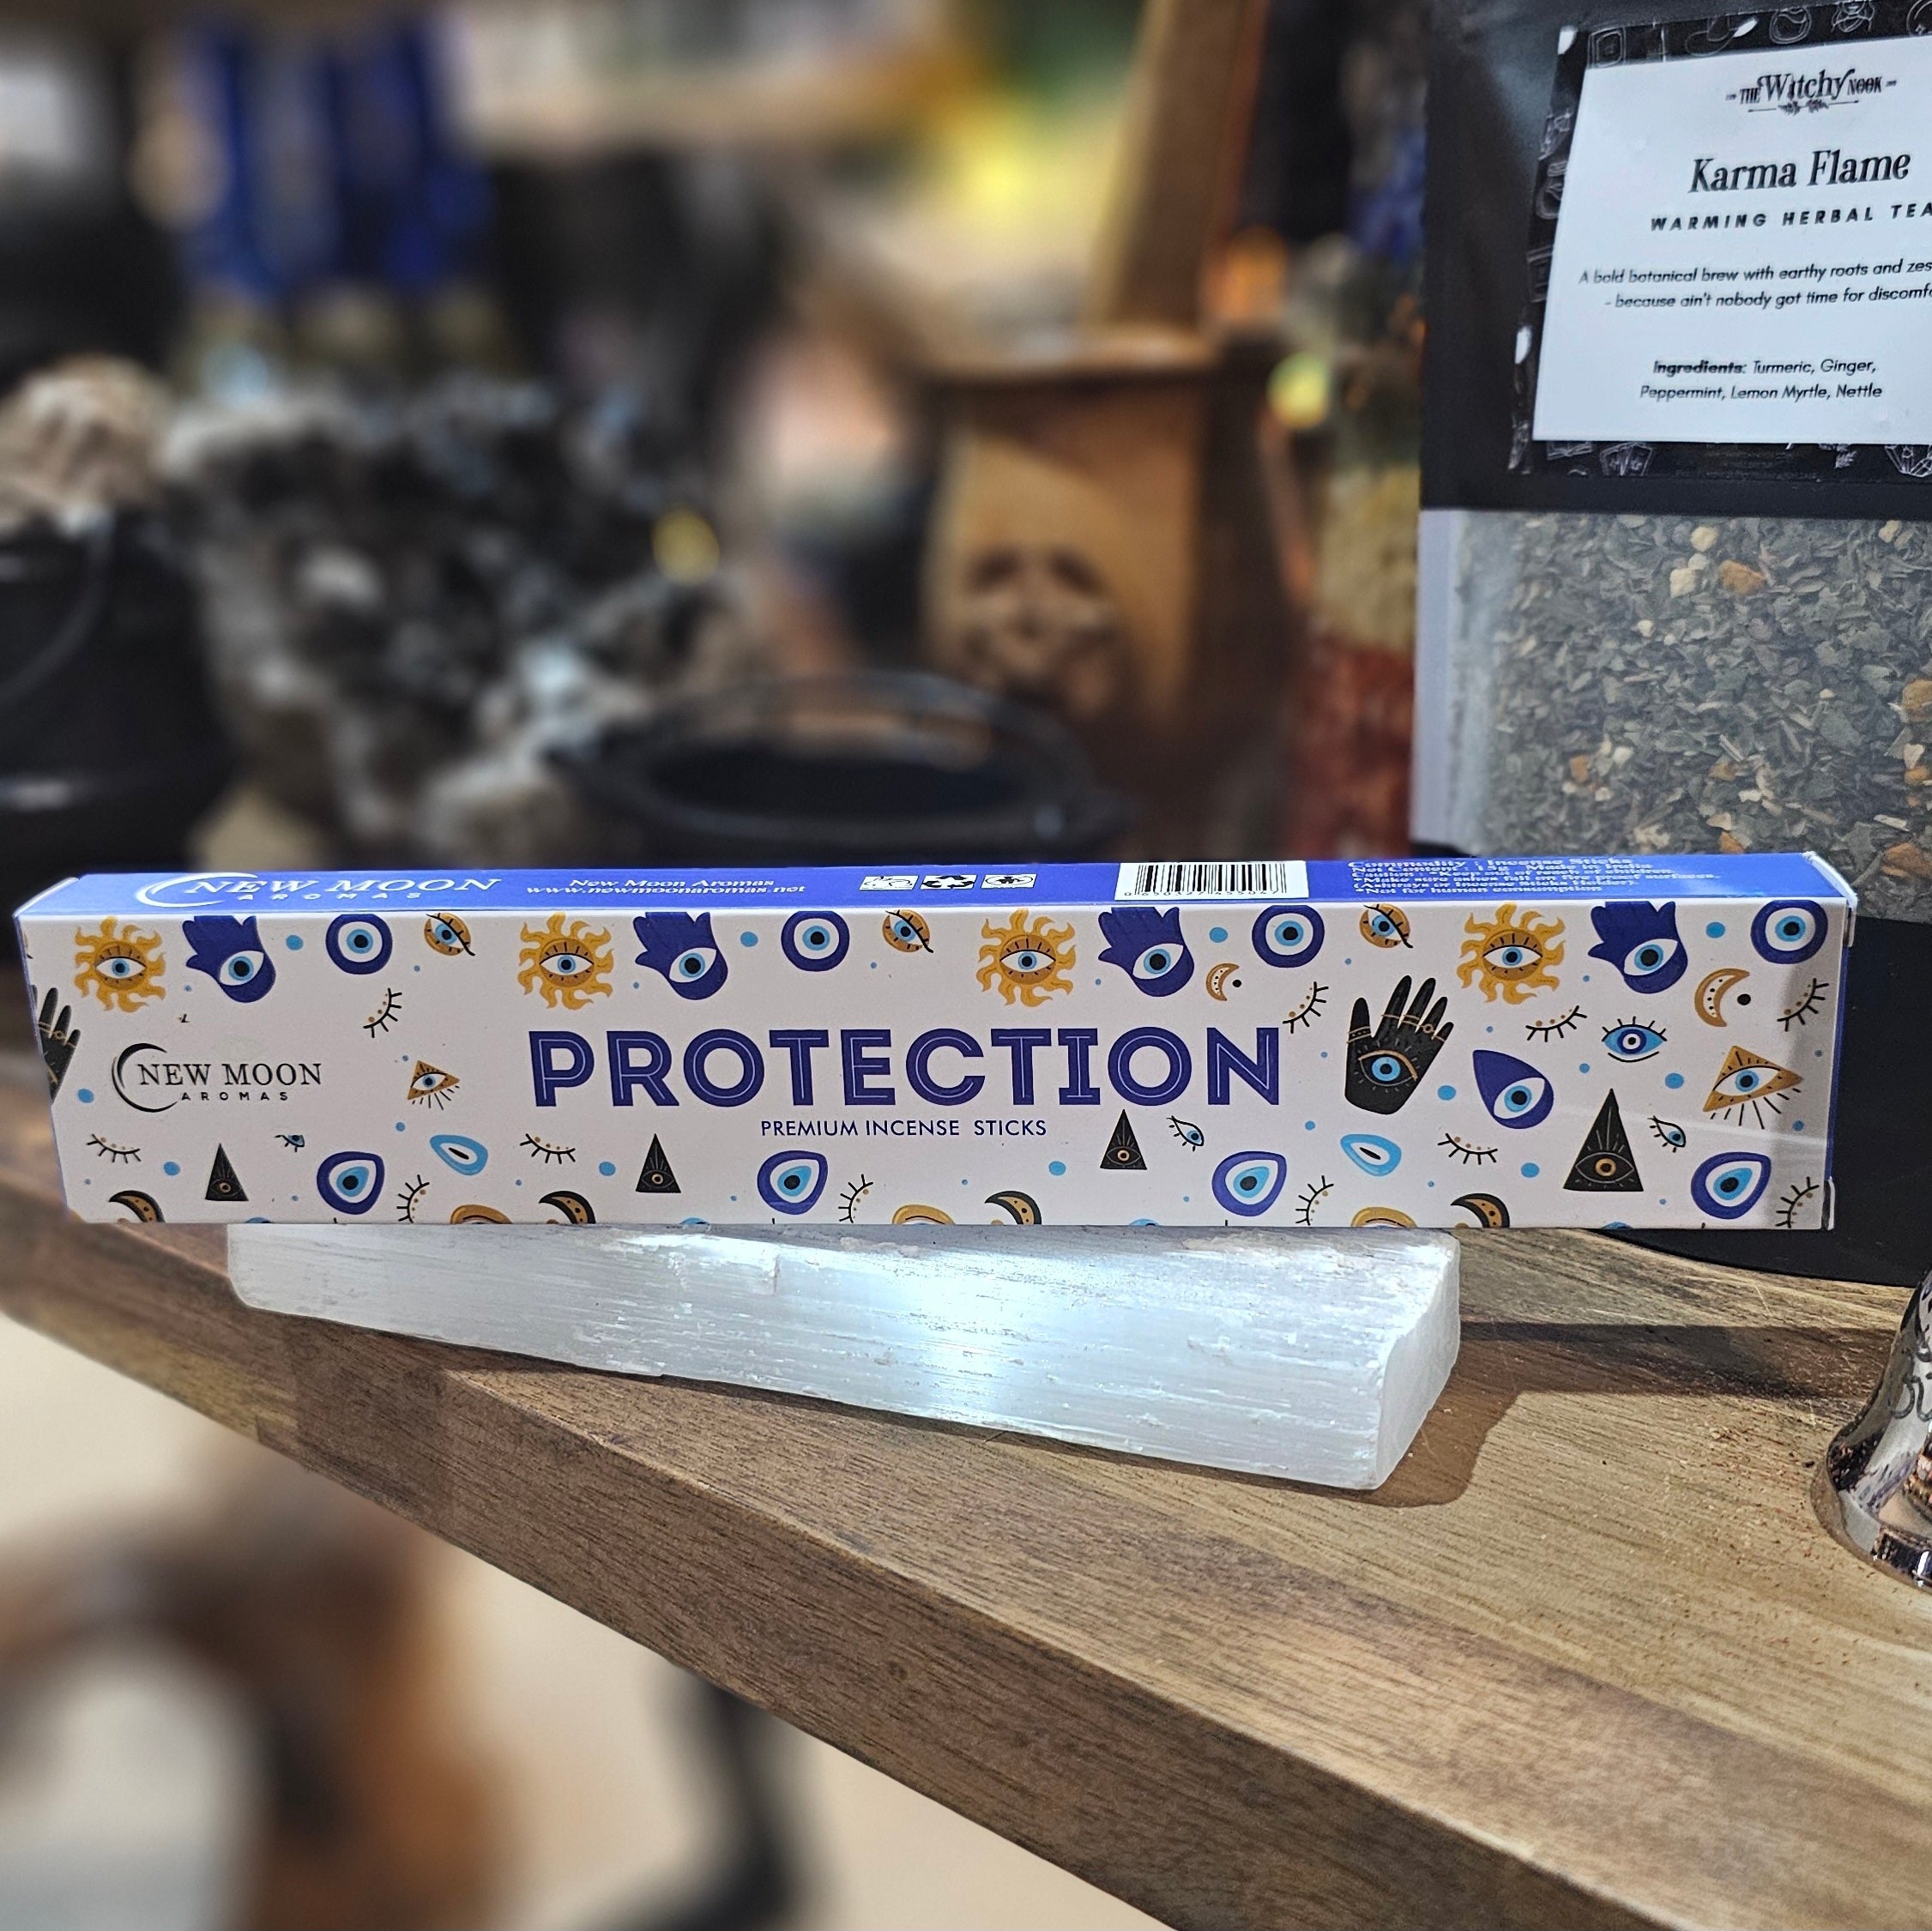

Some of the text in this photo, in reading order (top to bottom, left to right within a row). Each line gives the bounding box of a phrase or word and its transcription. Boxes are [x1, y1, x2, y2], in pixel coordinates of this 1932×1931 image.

[1740, 69, 1883, 105] THE Witchy NOOK
[1687, 149, 1911, 193] Karma Flame
[1650, 202, 1932, 232] WARMING HERBAL TEA
[1578, 269, 1590, 285] A
[1592, 269, 1626, 284] bold
[1628, 268, 1699, 284] botanical
[1700, 267, 1739, 282] brew
[1742, 265, 1774, 281] with
[1778, 263, 1828, 283] earthy
[1829, 263, 1869, 277] roots
[1872, 258, 1905, 275] and
[1614, 293, 1677, 309] because
[1679, 293, 1713, 307] ain't
[1715, 291, 1772, 311] nobody
[1774, 293, 1802, 311] got
[1806, 291, 1838, 305] time
[1842, 287, 1866, 303] for
[1652, 359, 1878, 378] Ingredients: Turmeric, Ginger,
[1639, 382, 1884, 403] Peppermint, Lemon Myrtle, Nettle
[184, 878, 502, 894] NEW MOON
[237, 892, 421, 901] AROMAS
[136, 1062, 323, 1086] NEW MOON
[528, 1027, 1280, 1107] PROTECTION
[180, 1090, 289, 1101] AROMAS
[760, 1119, 1048, 1137] PREMIUM INCENSE STICKS
